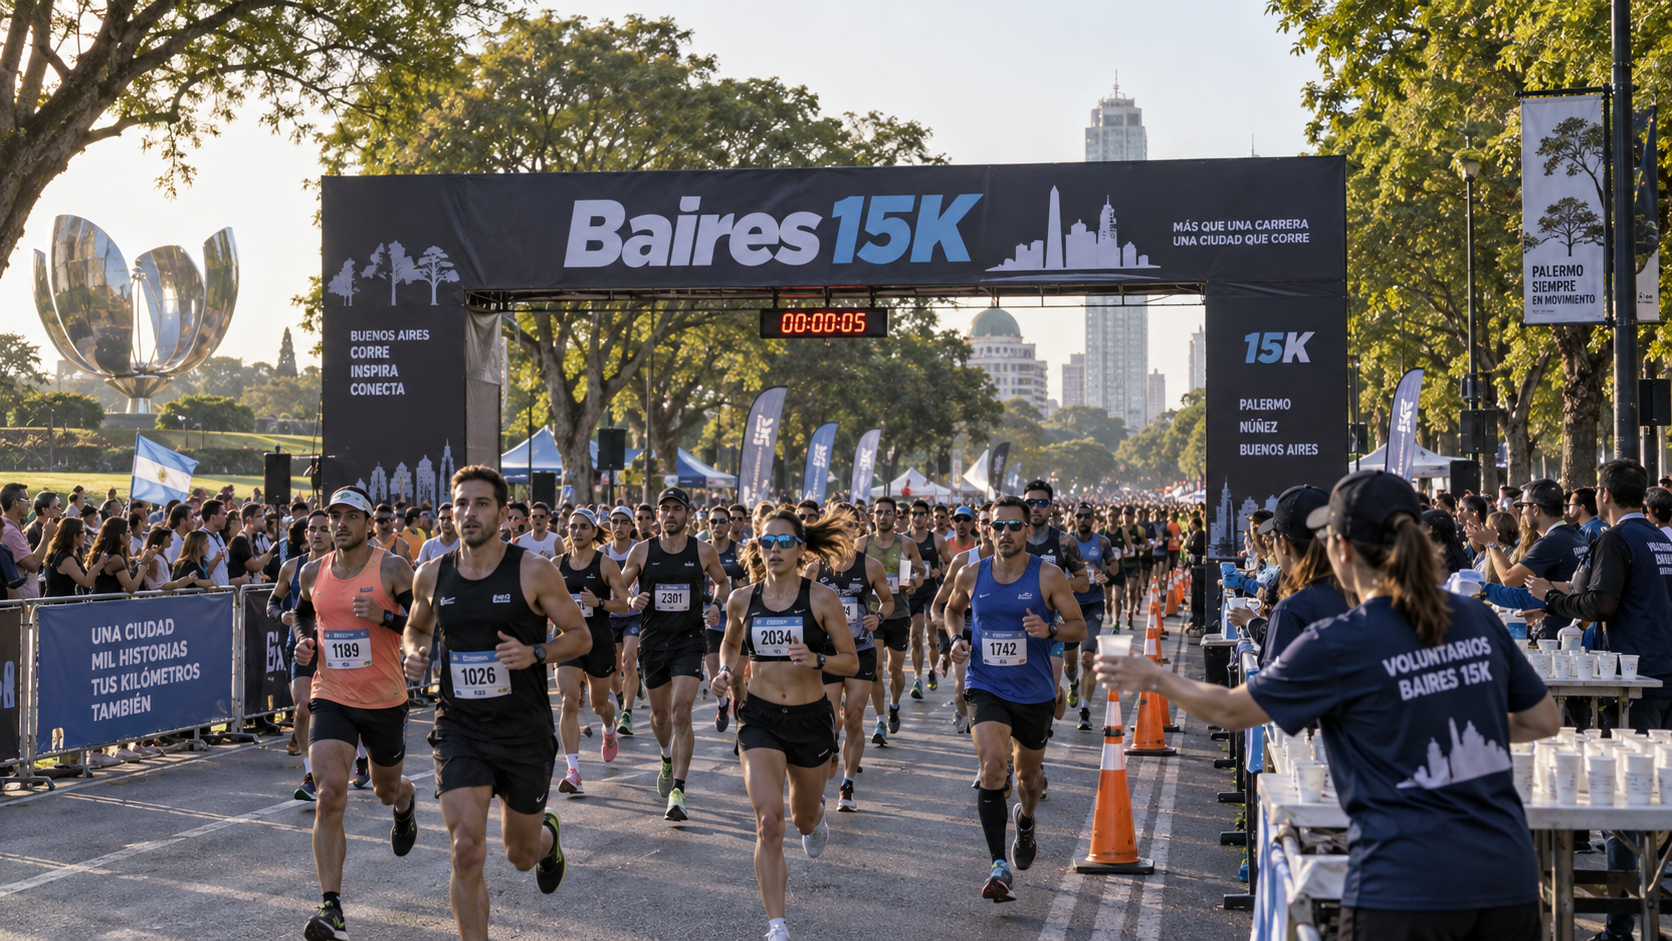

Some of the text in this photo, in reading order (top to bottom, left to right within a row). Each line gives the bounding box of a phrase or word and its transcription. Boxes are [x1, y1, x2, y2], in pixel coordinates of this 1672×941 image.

[563, 193, 983, 268] Baires 15K
[1173, 219, 1310, 232] MÁS QUE UNA CARRERA
[1173, 233, 1310, 246] UNA CIUDAD QUE CORRE
[1532, 264, 1584, 278] PALERMO
[1532, 279, 1576, 293] SIEMPRE
[1532, 294, 1596, 306] EN MOVIMIENTO
[781, 312, 866, 334] 00:00:05
[350, 329, 430, 342] BUENOS AIRES
[350, 345, 390, 360] CORRE
[1244, 331, 1316, 364] 15K
[350, 363, 399, 378] INSPIRA
[350, 382, 406, 396] CONECTA
[1239, 398, 1292, 411] PALERMO
[1239, 418, 1278, 434] NÚÑEZ
[1239, 443, 1319, 456] BUENOS AIRES
[661, 592, 682, 604] 2301
[91, 618, 175, 645] UNA CIUDAD
[761, 629, 792, 646] 2034
[91, 640, 188, 671] MIL HISTORIAS
[332, 642, 359, 658] 1189
[990, 642, 1018, 657] 1742
[1381, 636, 1492, 677] VOLUNTARIOS
[91, 662, 201, 696] TUS KILÓMETROS
[461, 666, 496, 686] 1026
[1398, 660, 1494, 701] BAIRES 15K
[91, 692, 151, 722] TAMBIÉN
